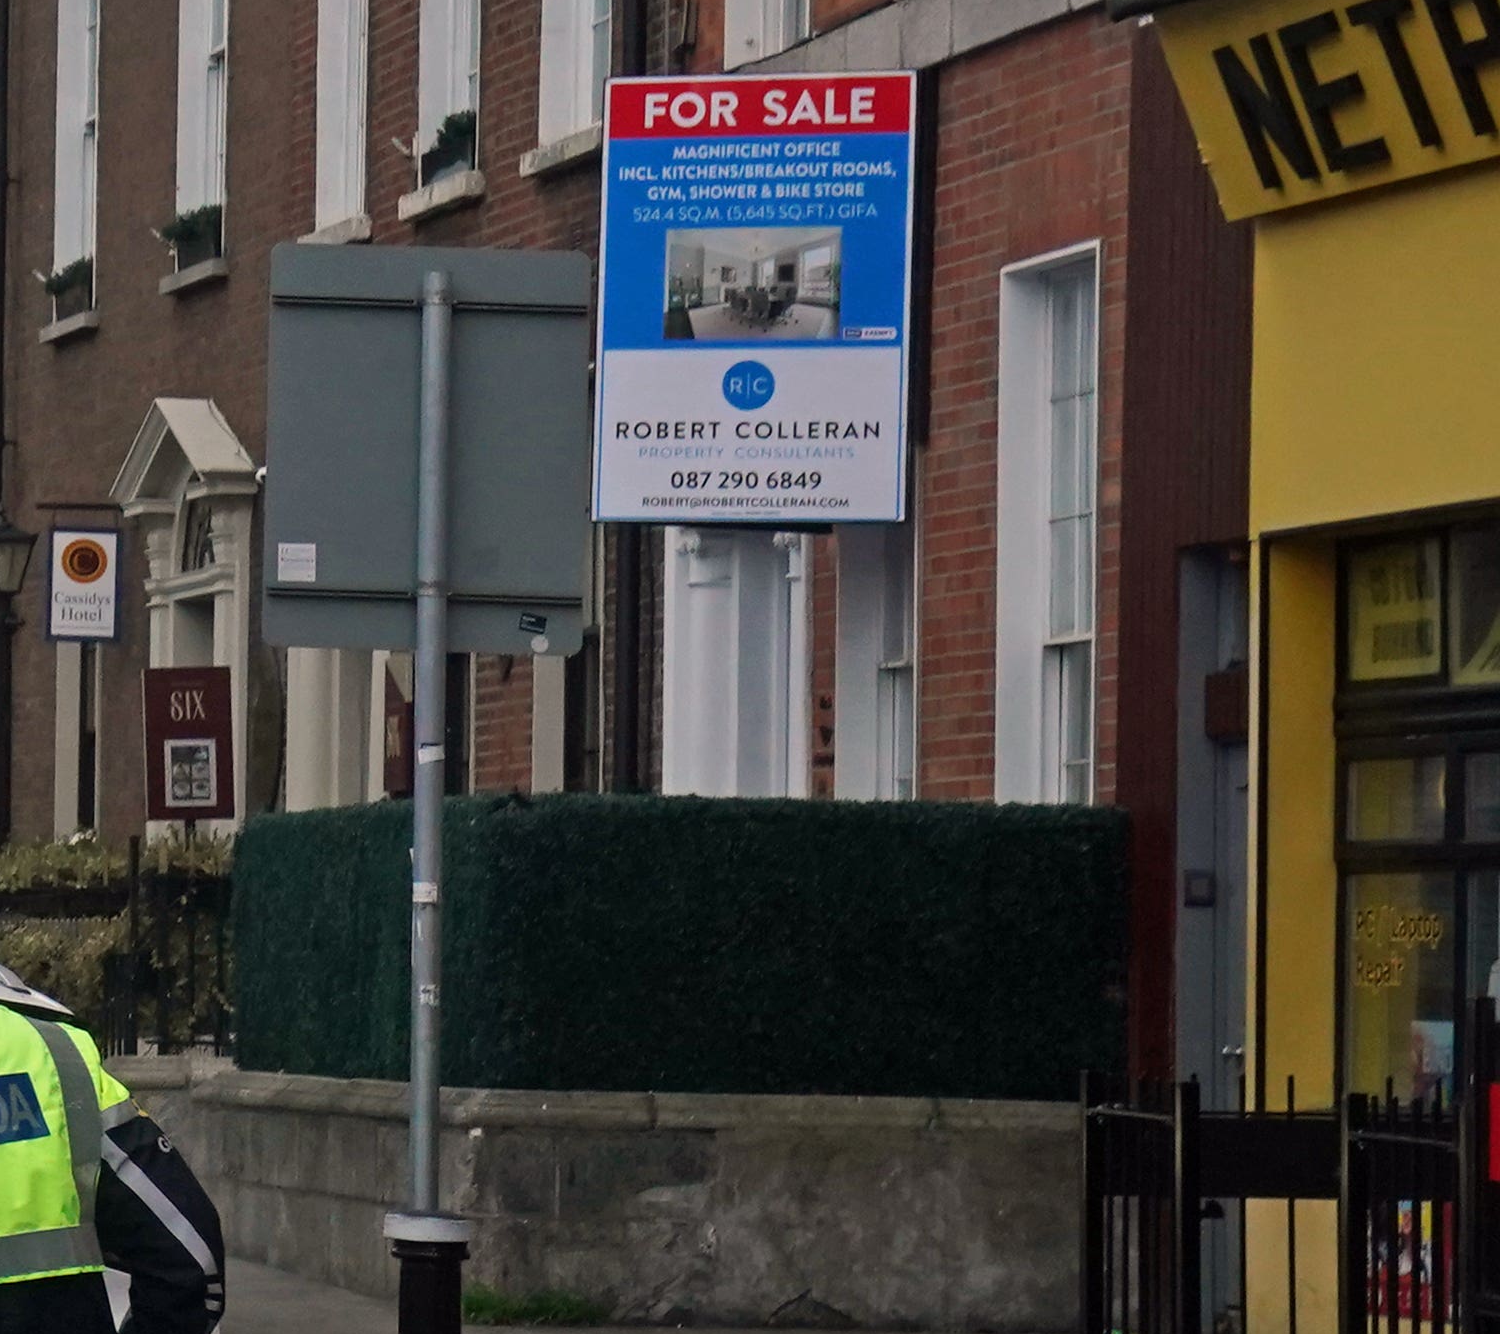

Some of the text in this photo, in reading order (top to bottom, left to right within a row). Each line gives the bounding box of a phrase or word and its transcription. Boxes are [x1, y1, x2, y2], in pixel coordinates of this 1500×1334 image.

[644, 86, 876, 129] FOR SALE
[673, 141, 841, 160] MAGNIFICENT OFFICE
[619, 161, 897, 181] INCL. KITCHENS/BREAKOUT ROOMS,
[647, 182, 865, 202] GYM, SHOWER & BIKE STORE
[616, 421, 881, 439] ROBERT COLLERAN
[639, 446, 855, 460] PROPERTY CONSULTANTS
[671, 471, 821, 489] 087 290 6849
[642, 496, 850, 509] ROBERT@ROBERTCOLLERAN.COM
[54, 590, 111, 607] Cassidys
[60, 607, 103, 622] Hotel
[170, 690, 206, 722] SIX
